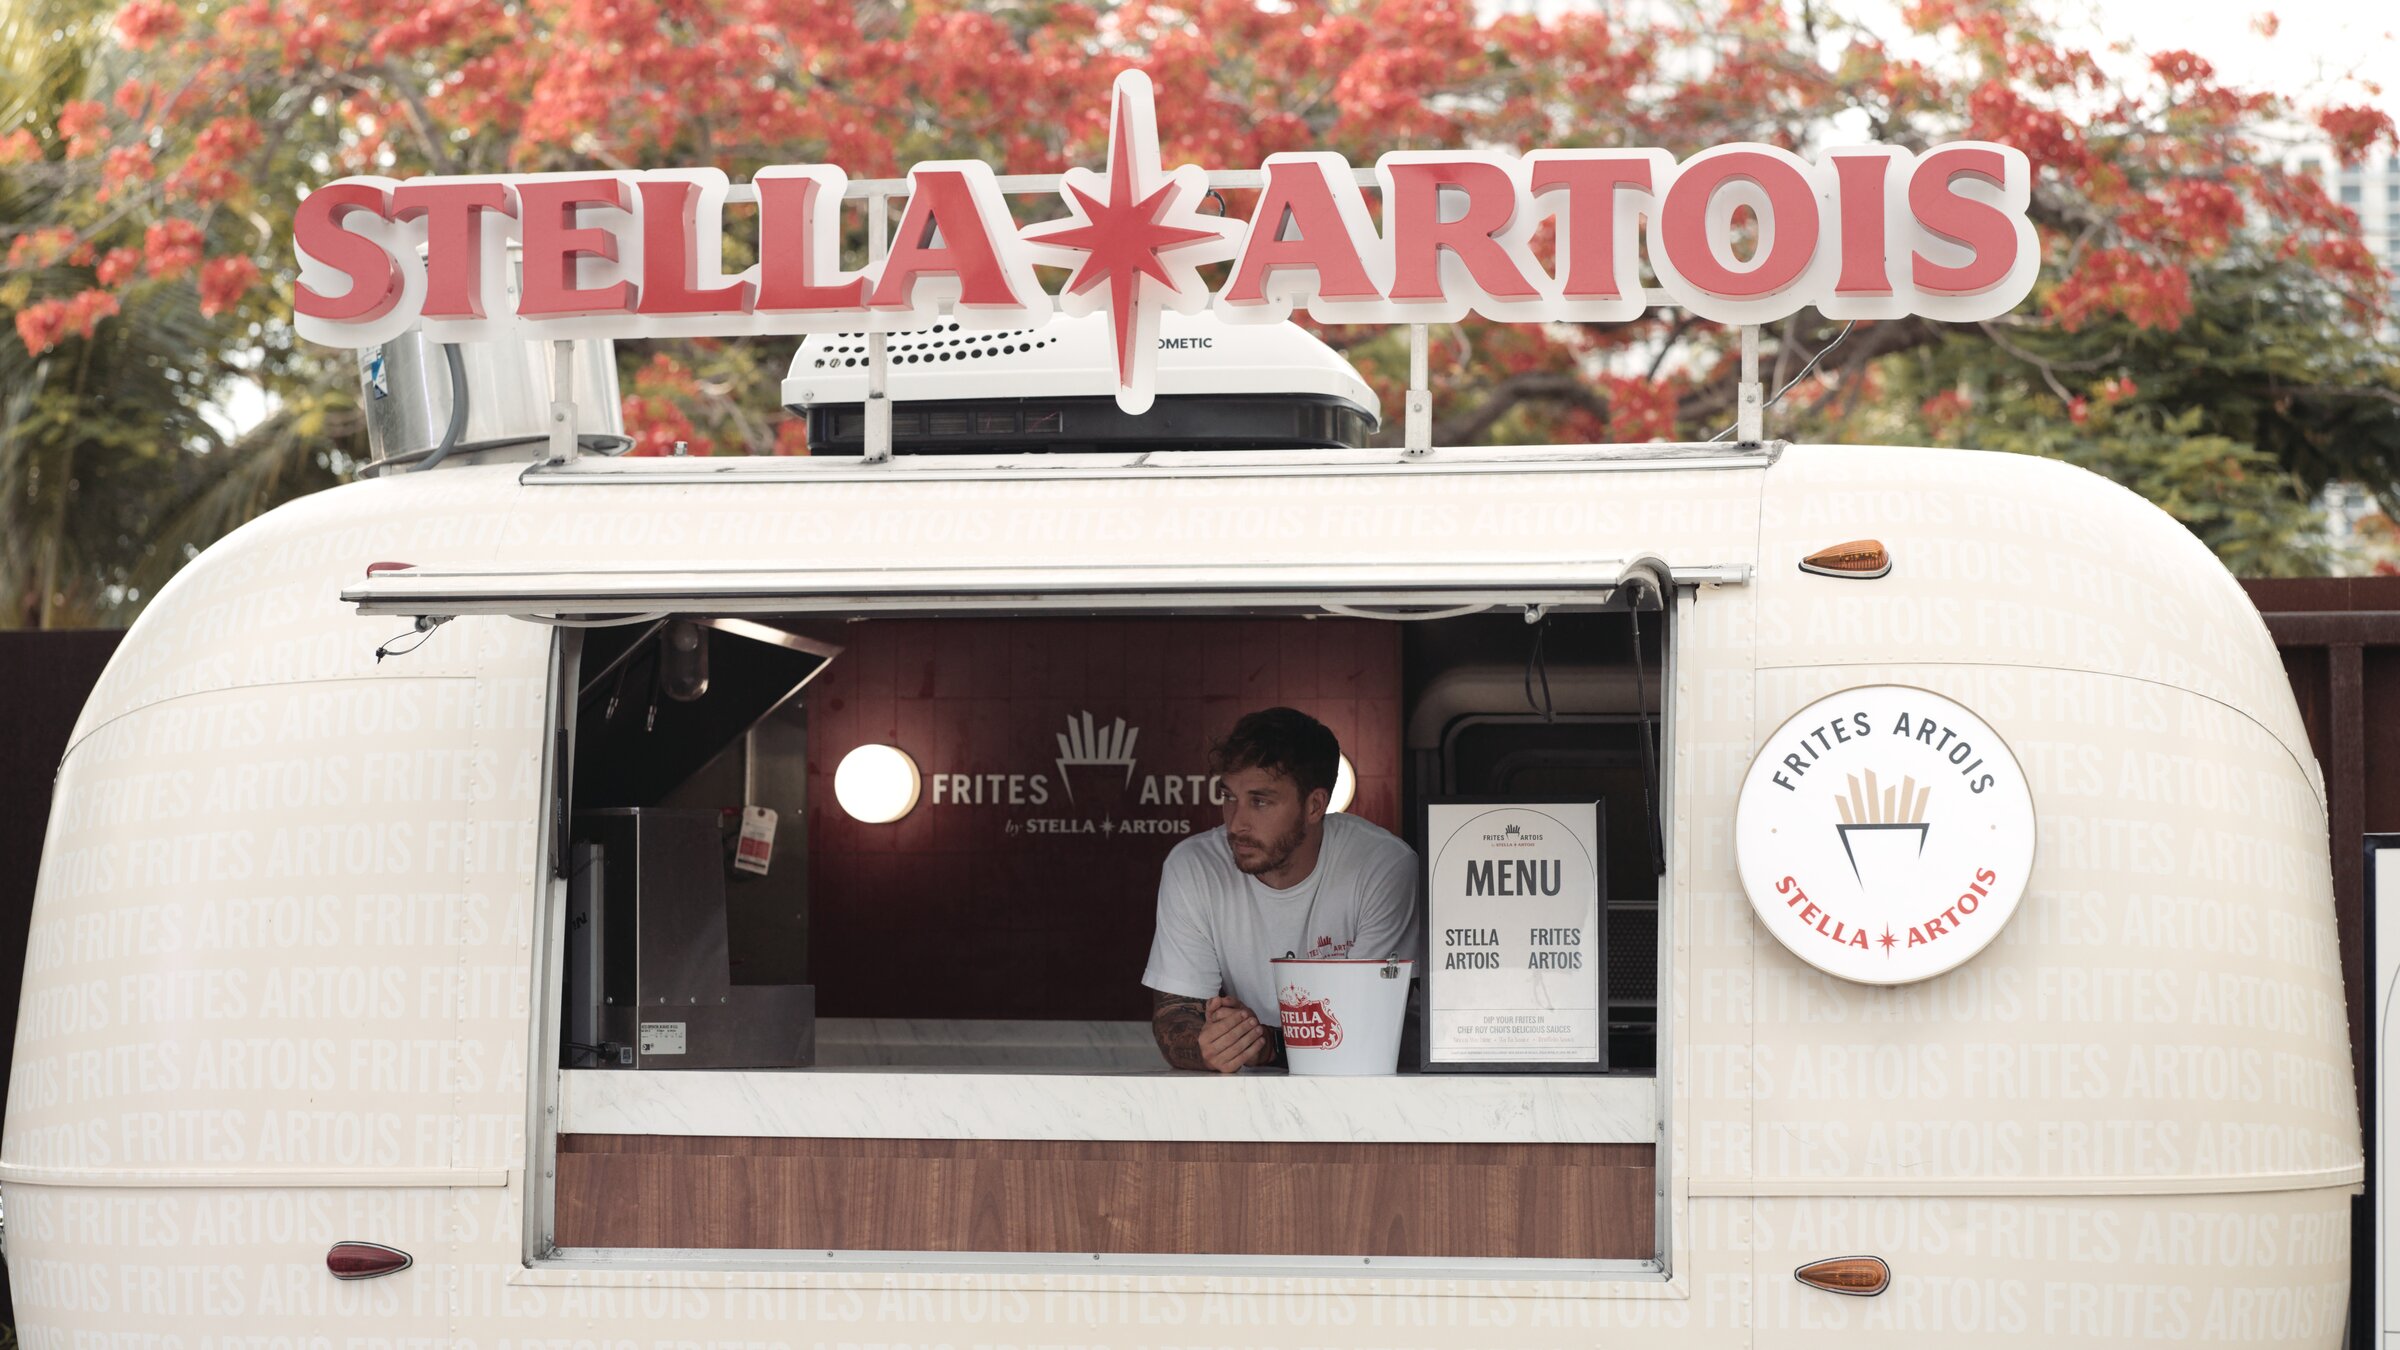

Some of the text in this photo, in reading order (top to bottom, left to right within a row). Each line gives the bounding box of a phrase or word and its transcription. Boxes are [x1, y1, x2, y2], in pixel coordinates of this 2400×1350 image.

[292, 148, 2020, 323] STELLA ARTOIS
[1158, 337, 1213, 349] OMETIC
[434, 676, 545, 730] FRITE
[1772, 711, 1995, 794] FRITES ARTOIS
[932, 773, 1224, 805] FRITES ARTO
[1004, 819, 1191, 837] by STELLA ARTOIS
[425, 820, 537, 874] FRITE
[1466, 860, 1561, 896] MENU
[1775, 867, 1996, 950] STELLA ARTOIS
[1445, 928, 1500, 946] STELLA
[1530, 928, 1581, 946] FRITES
[1445, 952, 1500, 970] ARTOIS
[1528, 951, 1582, 970] ARTOIS
[419, 965, 530, 1019] FRITE
[1281, 1010, 1323, 1024] STELLA
[1483, 1016, 1545, 1024] DIP YOUR FRITES IN
[1457, 1026, 1473, 1034] CHEF
[1512, 1026, 1544, 1034] DELICIOUS
[1546, 1026, 1572, 1034] SAUCES
[414, 1113, 525, 1168] FRITE
